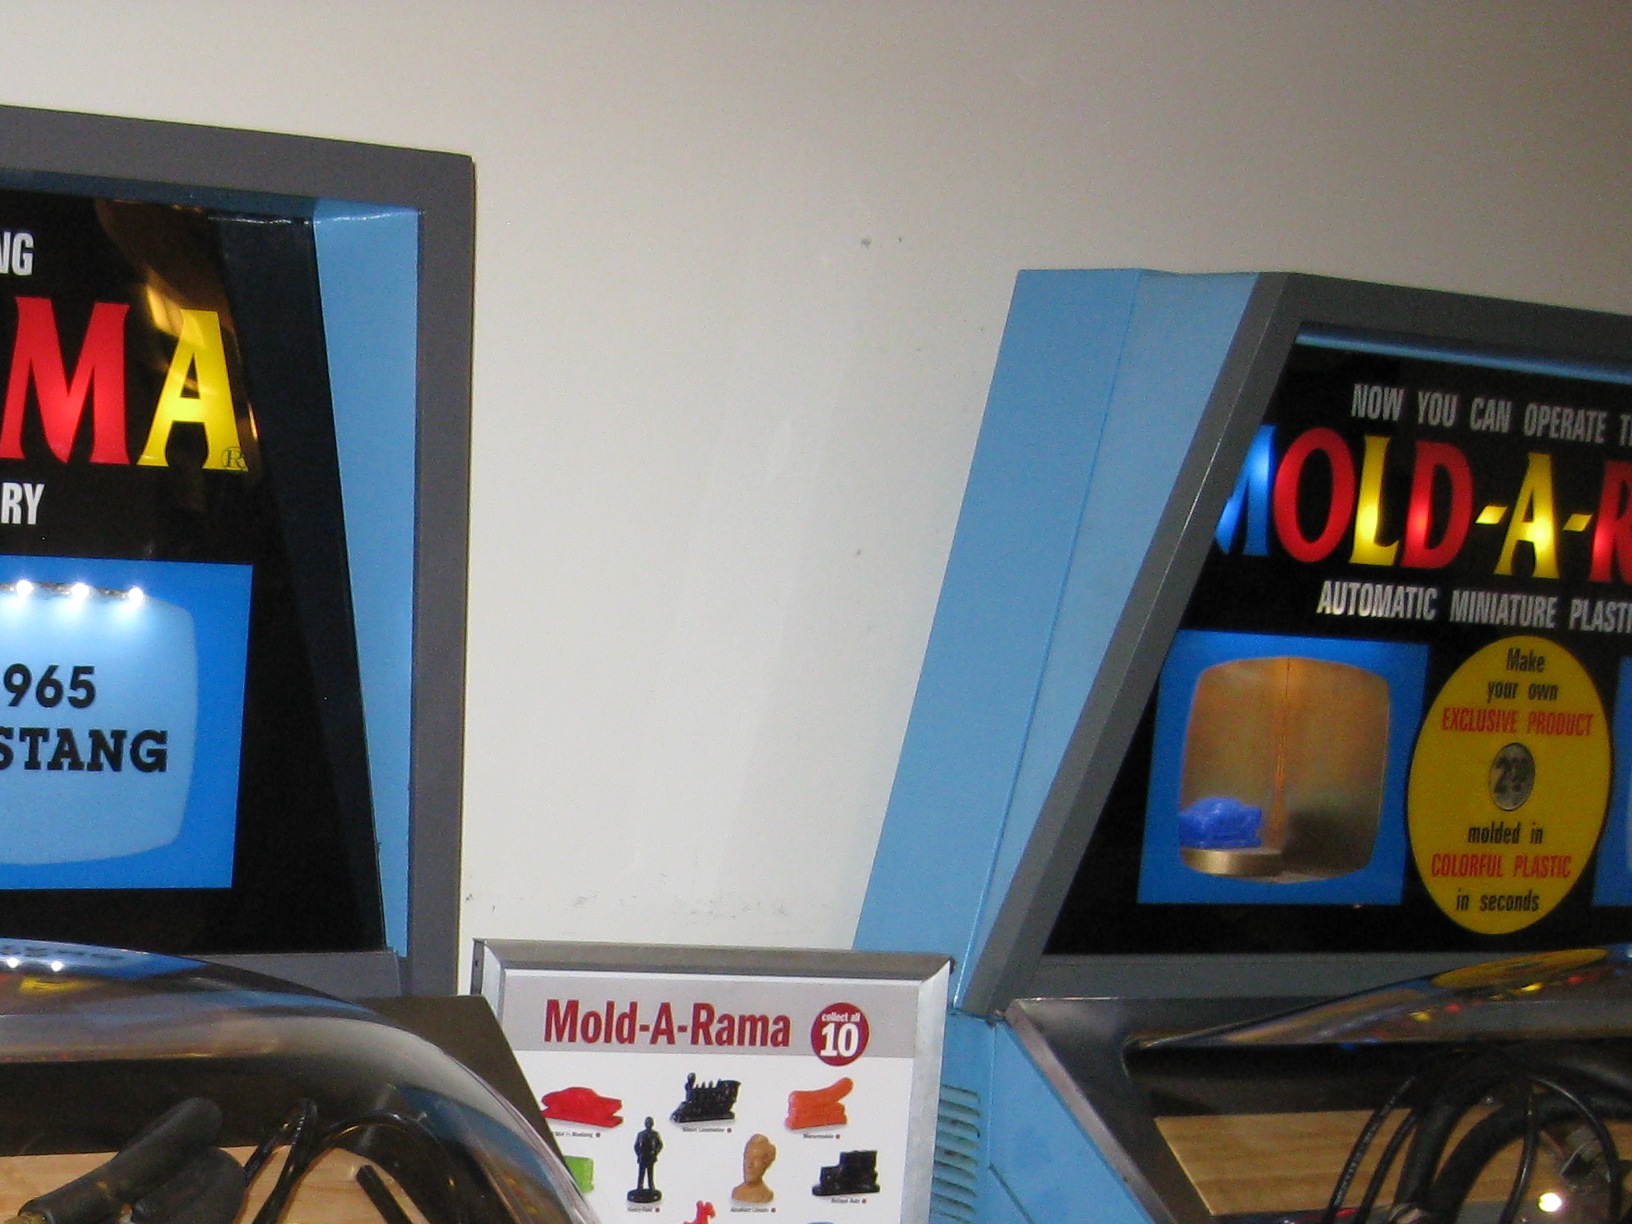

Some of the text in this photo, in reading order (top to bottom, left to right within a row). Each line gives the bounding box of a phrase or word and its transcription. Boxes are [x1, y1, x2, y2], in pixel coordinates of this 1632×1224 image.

[1351, 382, 1405, 422] NOW
[1418, 390, 1458, 428] YOU
[1469, 397, 1513, 433] CAN
[1524, 403, 1608, 444] OPERATE
[1316, 580, 1437, 620] AUTOMATIC
[1450, 589, 1559, 629] MINIATURE
[1506, 648, 1545, 673] Make
[1488, 681, 1558, 703] your own
[1441, 706, 1594, 737] EXCLUSIVE PRODUCT
[1468, 821, 1544, 844] molded in
[1431, 853, 1572, 878] COLORFUL PLASTIC
[1456, 889, 1540, 912] in seconds
[543, 998, 791, 1047] Mold-A-Rama
[819, 1022, 859, 1058] 10
